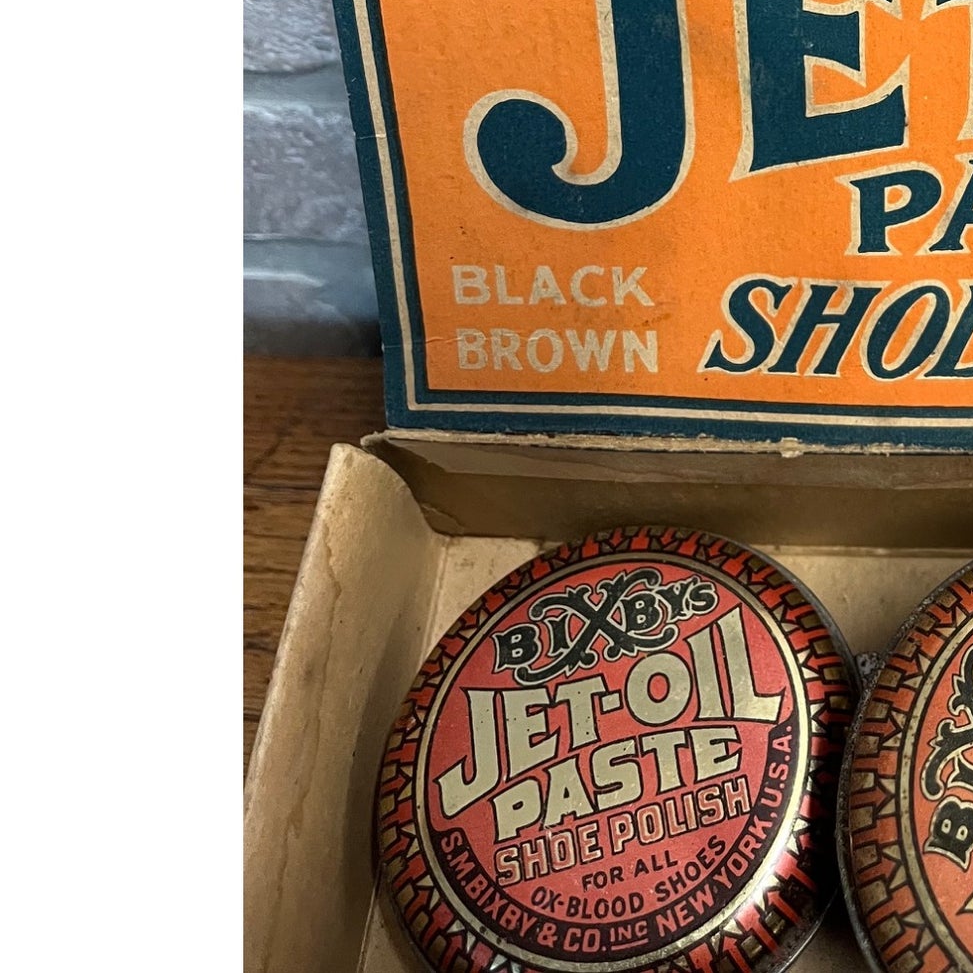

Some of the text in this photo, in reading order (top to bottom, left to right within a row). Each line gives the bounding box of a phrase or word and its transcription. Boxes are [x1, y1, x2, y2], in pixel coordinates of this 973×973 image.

[452, 264, 655, 308] BLACK
[456, 328, 658, 373] BROWN
[432, 604, 787, 819] JET-OIL
[491, 725, 742, 842] PASTE
[495, 775, 752, 886] SHOE POLISH
[530, 835, 726, 920] OX-BLOOD SHOES
[582, 850, 678, 892] FOR ALL
[536, 922, 558, 948] &
[655, 883, 715, 937] NEW
